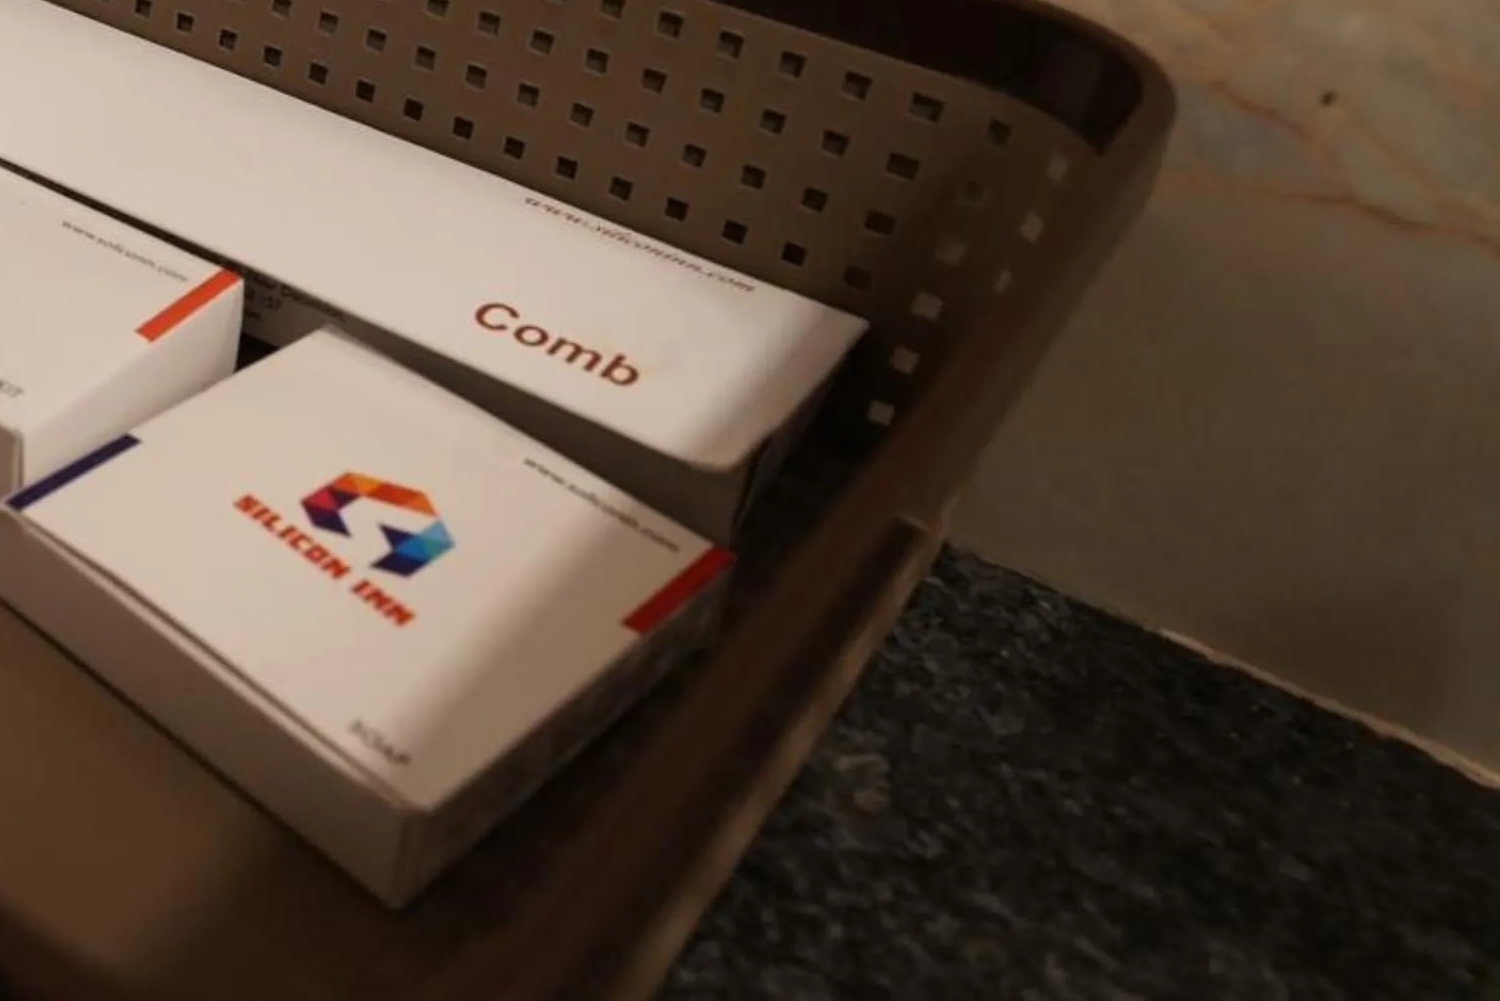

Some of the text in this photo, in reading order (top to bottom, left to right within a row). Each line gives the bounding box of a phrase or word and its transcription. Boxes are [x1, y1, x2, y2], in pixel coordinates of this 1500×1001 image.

[474, 302, 640, 387] Comb
[233, 494, 415, 628] SILICON INN
